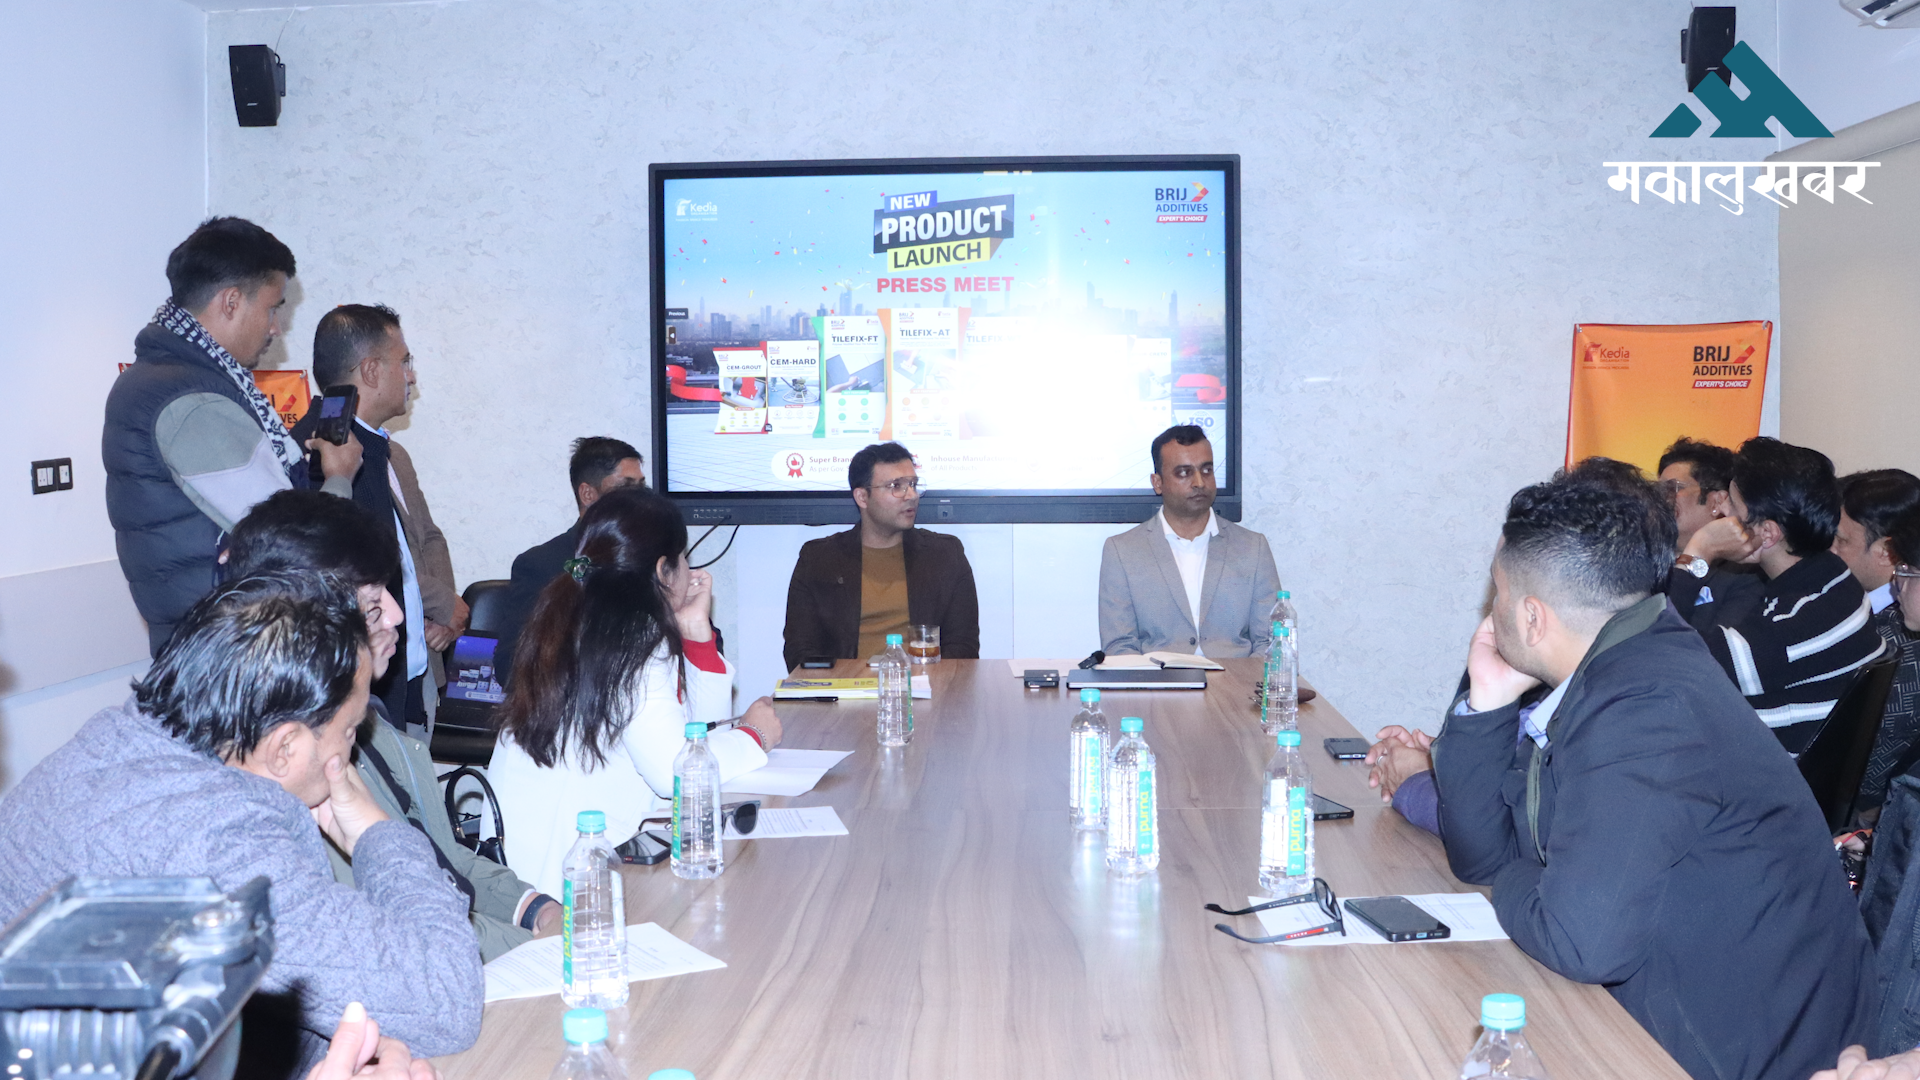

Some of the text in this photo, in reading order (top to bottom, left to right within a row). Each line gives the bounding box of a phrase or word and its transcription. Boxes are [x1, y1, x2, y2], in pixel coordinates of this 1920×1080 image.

[1155, 187, 1188, 201] BRIJ
[690, 201, 718, 212] Kedia
[890, 192, 931, 210] NEW
[1155, 203, 1208, 212] ADDITIVES
[881, 204, 1007, 245] PRODUCT
[893, 241, 982, 269] LAUNCH
[877, 276, 1015, 294] PRESS MEET
[832, 335, 879, 343] TILEFIX-FT
[900, 329, 951, 337] TILEFIX-AT
[1600, 346, 1630, 359] Kedia
[1693, 345, 1731, 362] BRIJ
[770, 358, 817, 366] CEM-HARD
[1692, 364, 1753, 376] ADDITIVES
[1694, 380, 1749, 388] EXPERT'S CHOICE
[1188, 416, 1215, 428] ISO
[809, 456, 831, 464] Super
[1140, 791, 1152, 832] purna
[1290, 809, 1303, 852] purna
